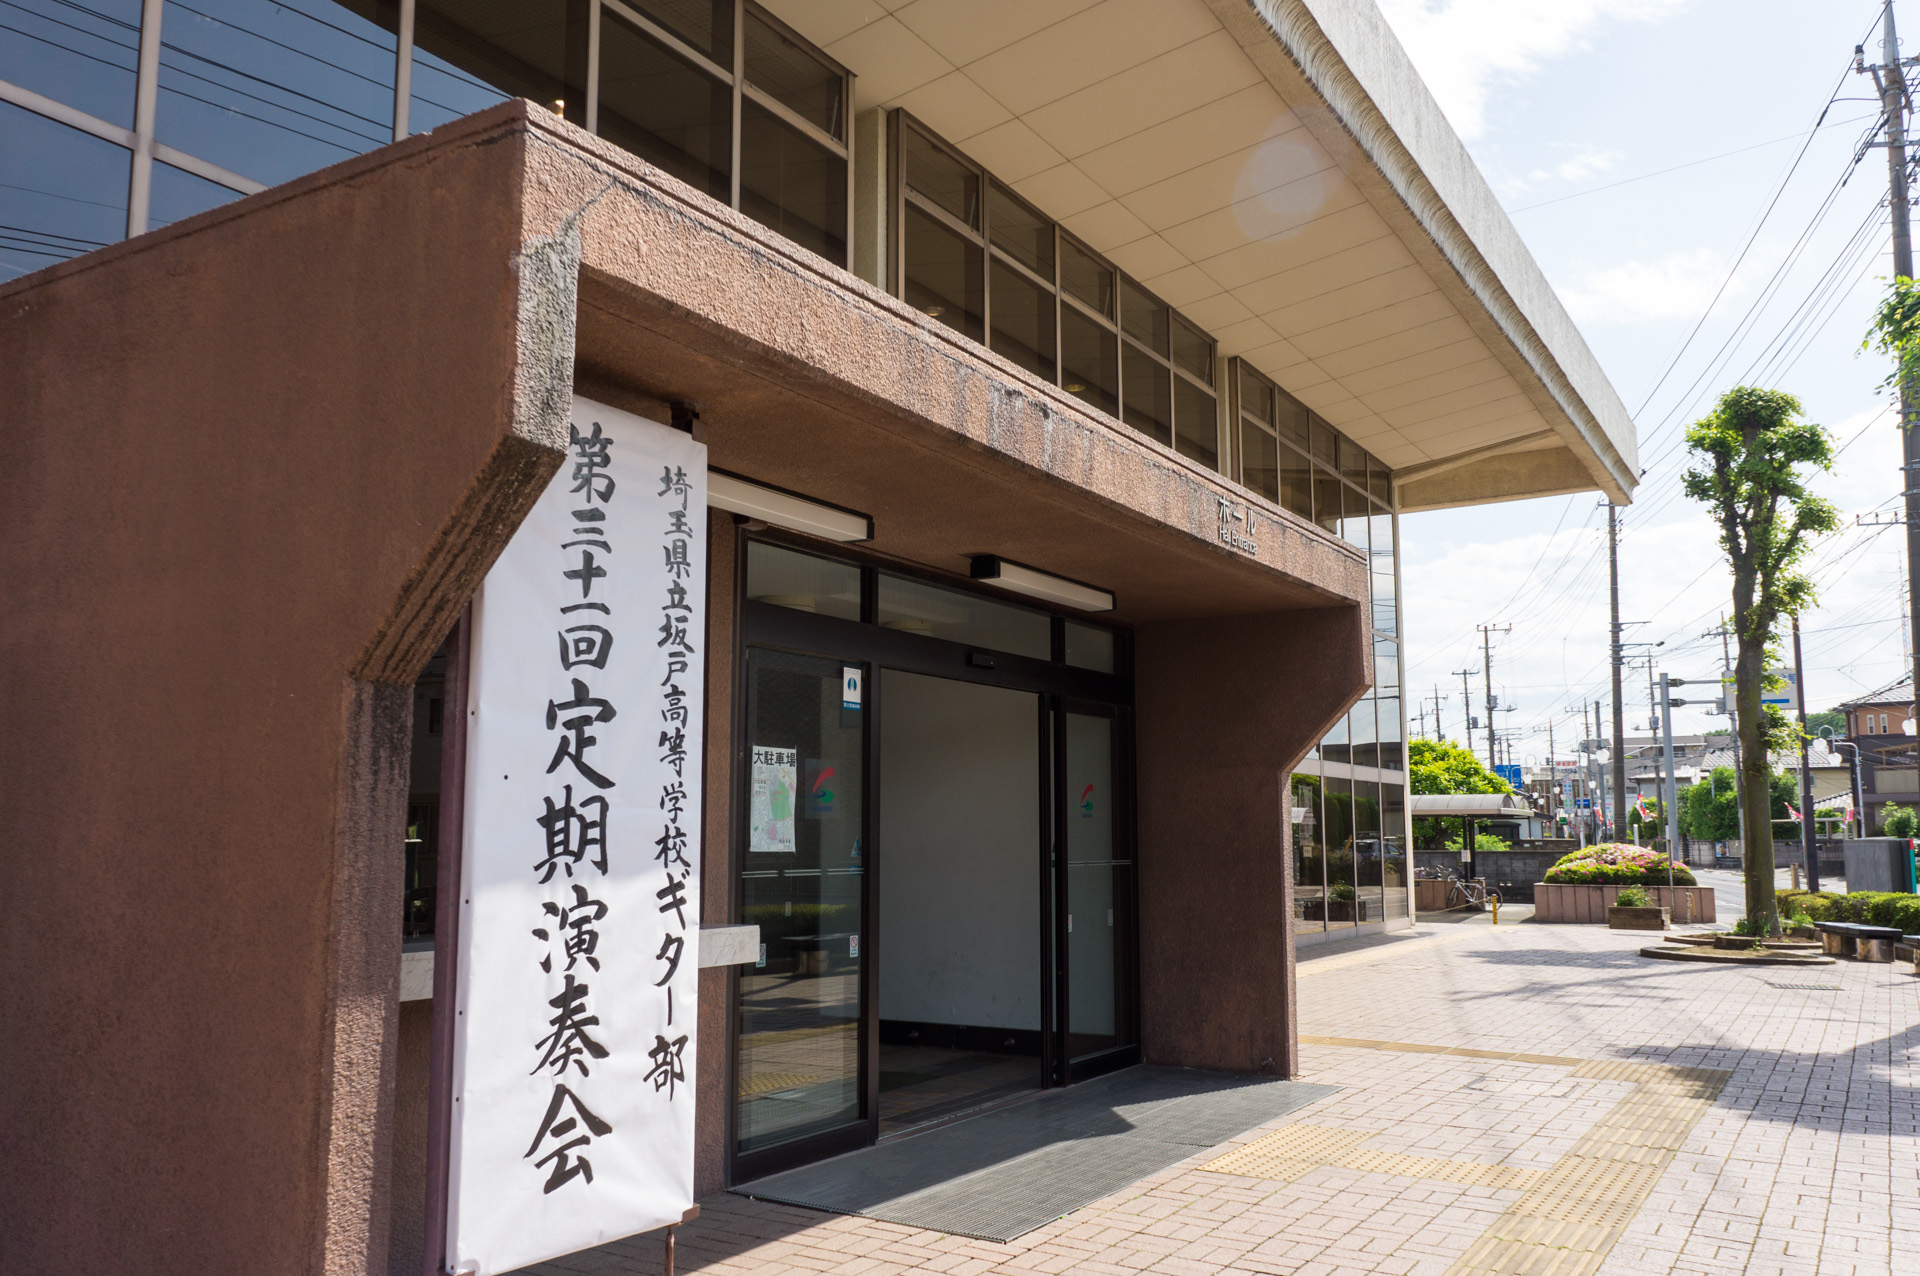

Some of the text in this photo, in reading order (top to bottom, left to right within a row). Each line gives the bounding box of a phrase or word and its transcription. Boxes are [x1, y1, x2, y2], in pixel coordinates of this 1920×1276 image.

[1218, 494, 1257, 536] ホール
[1219, 524, 1232, 543] Hall
[753, 749, 797, 768] 大駐車場
